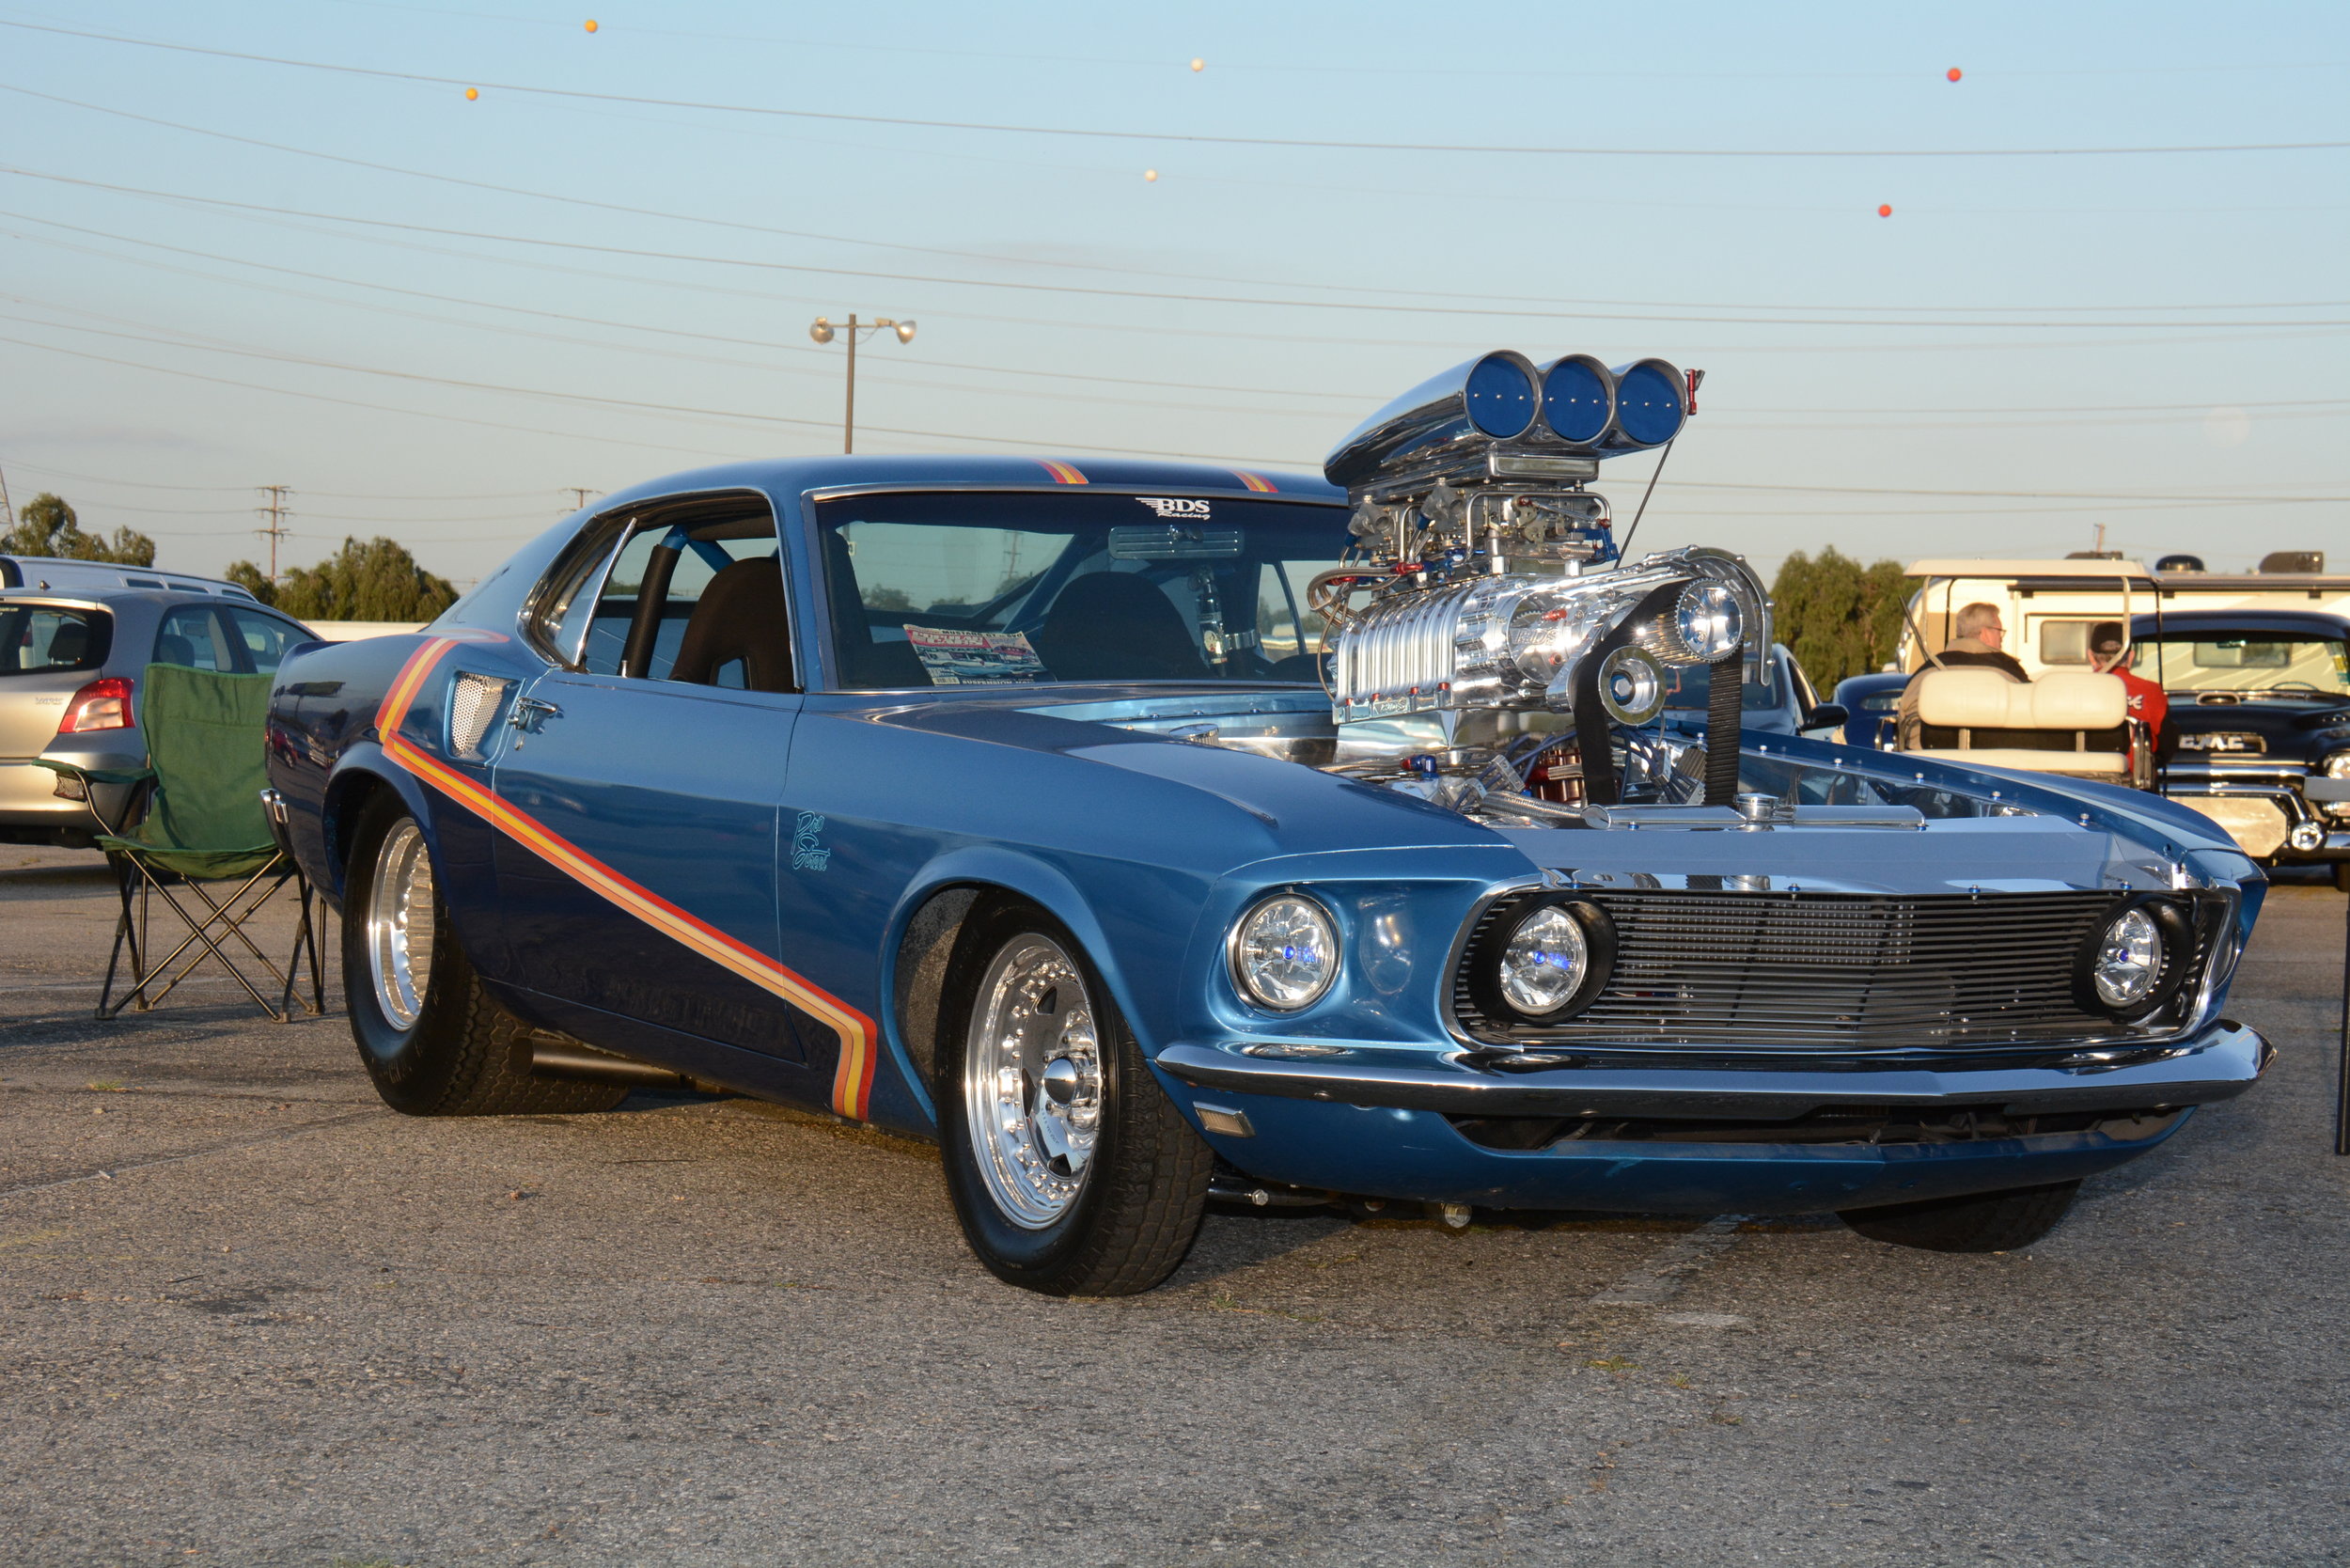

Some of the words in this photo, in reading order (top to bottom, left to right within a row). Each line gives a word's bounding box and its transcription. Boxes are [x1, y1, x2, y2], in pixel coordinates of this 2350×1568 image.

[1157, 498, 1211, 513] BDS
[1155, 510, 1211, 521] Racing
[2179, 735, 2245, 751] GMC
[791, 810, 825, 855] Pro
[792, 833, 831, 871] Street
